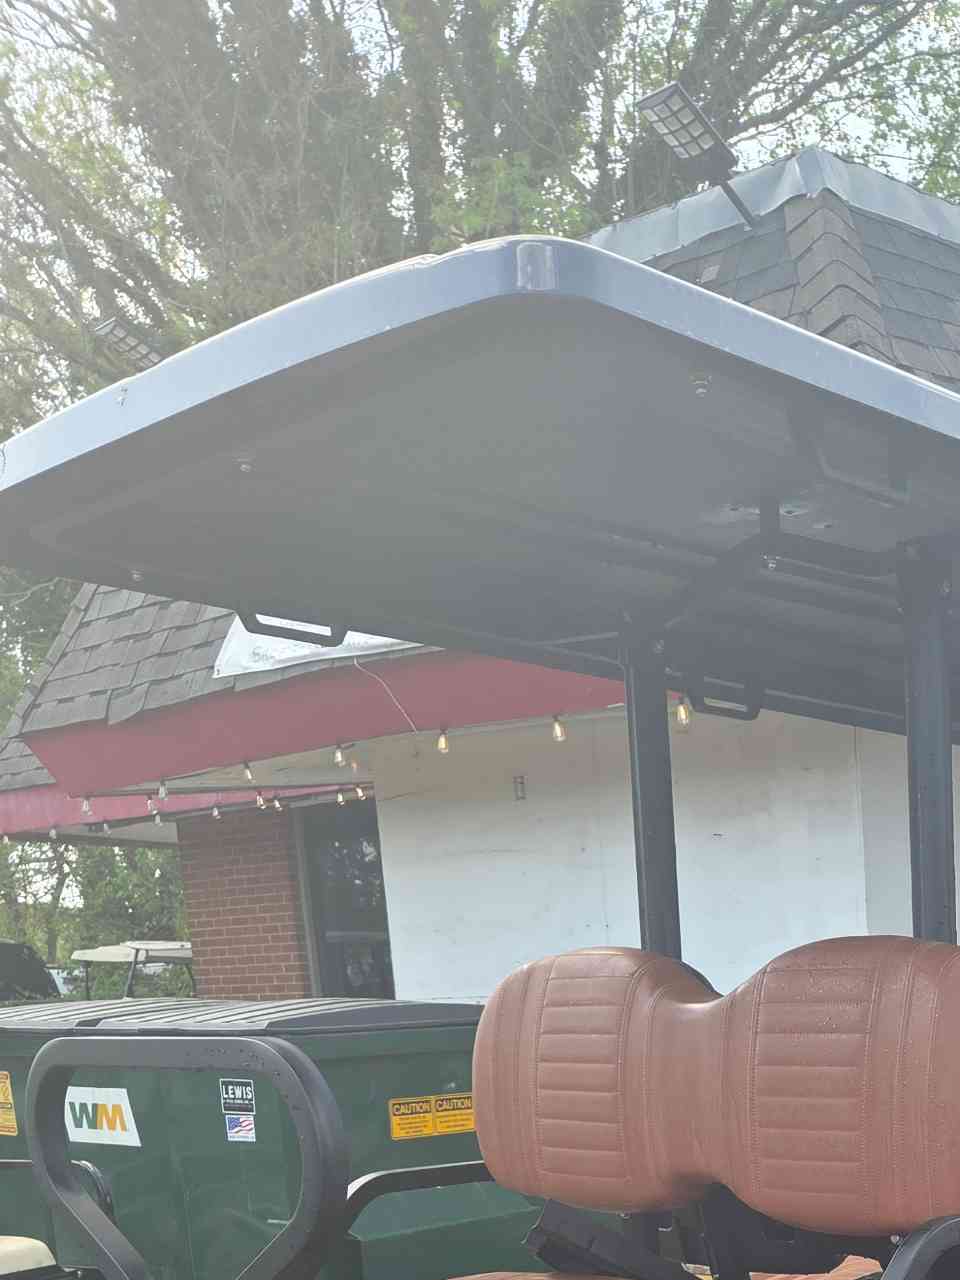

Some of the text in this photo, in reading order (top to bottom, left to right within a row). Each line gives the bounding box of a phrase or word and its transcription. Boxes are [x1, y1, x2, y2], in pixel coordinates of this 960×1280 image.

[222, 1085, 252, 1099] LEWIS
[394, 1102, 431, 1115] CAUTION
[436, 1096, 472, 1111] CAUTION
[69, 1102, 127, 1131] WM
